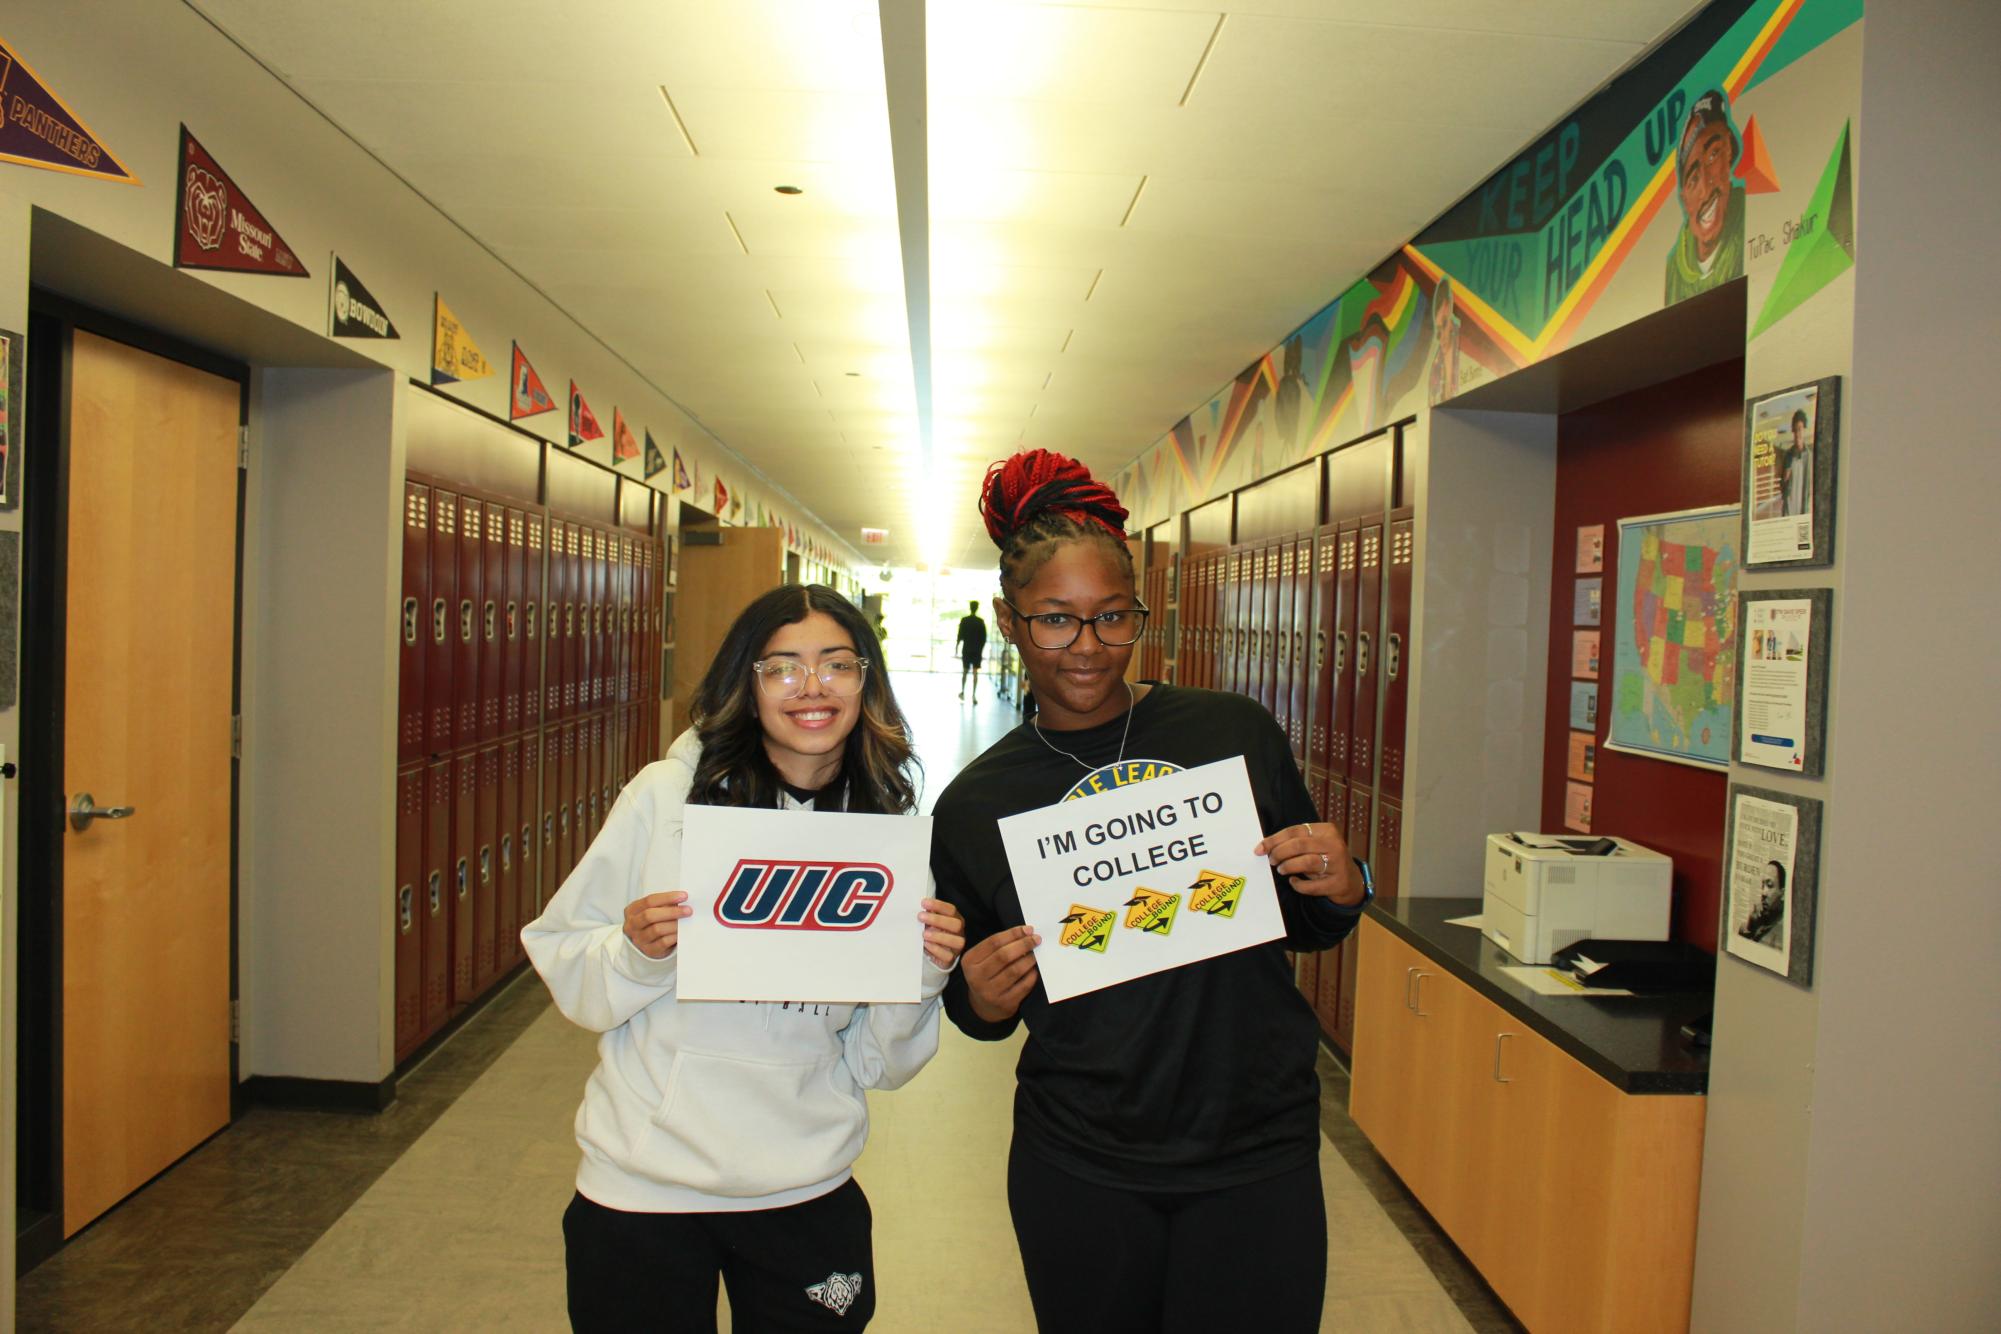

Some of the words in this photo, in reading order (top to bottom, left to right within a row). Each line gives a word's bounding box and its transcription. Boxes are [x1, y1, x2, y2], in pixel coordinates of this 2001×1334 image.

[9, 95, 101, 169] PANTHERS
[1477, 121, 1581, 234] KEEP
[1544, 159, 1628, 322] HEAD
[1643, 88, 1687, 167] UP
[230, 208, 272, 249] Missouri
[238, 233, 264, 261] State
[1464, 237, 1522, 321] YOUR
[1037, 831, 1077, 859] I'M
[1085, 804, 1178, 846] GOING
[1183, 791, 1223, 819] TO
[1073, 834, 1208, 887] COLLEGE
[719, 864, 888, 926] UIC
[1151, 895, 1177, 918] BOUND
[1194, 882, 1227, 910] COLLEGE
[1215, 878, 1241, 901] BOUND
[1066, 915, 1099, 944] COLLEGE
[1087, 912, 1113, 936] BOUND
[1130, 899, 1163, 928] COLLEGE
